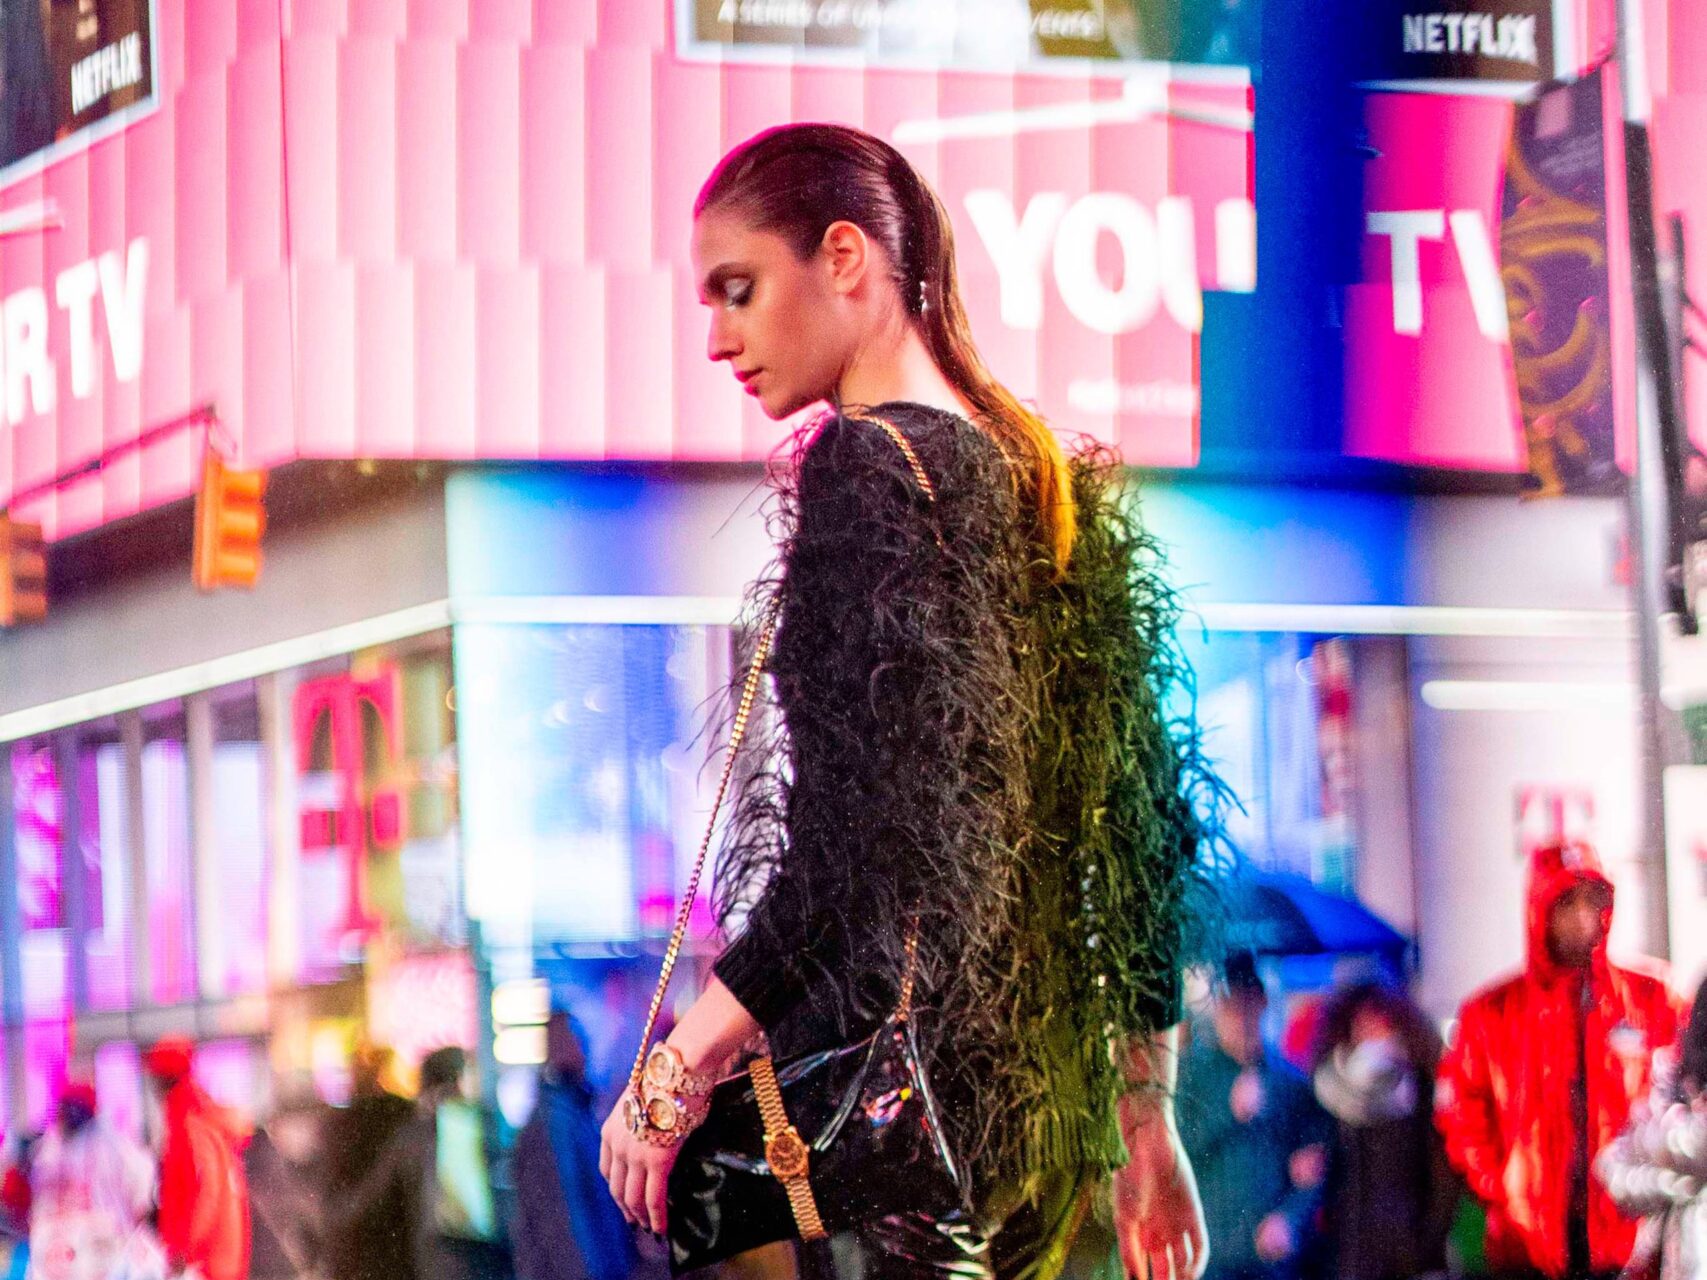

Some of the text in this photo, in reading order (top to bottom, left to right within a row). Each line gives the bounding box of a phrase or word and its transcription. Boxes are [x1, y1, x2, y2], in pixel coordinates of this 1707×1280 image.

[70, 31, 144, 115] NETFLIX
[1401, 11, 1538, 66] NETFLIX
[0, 235, 149, 427] R TV
